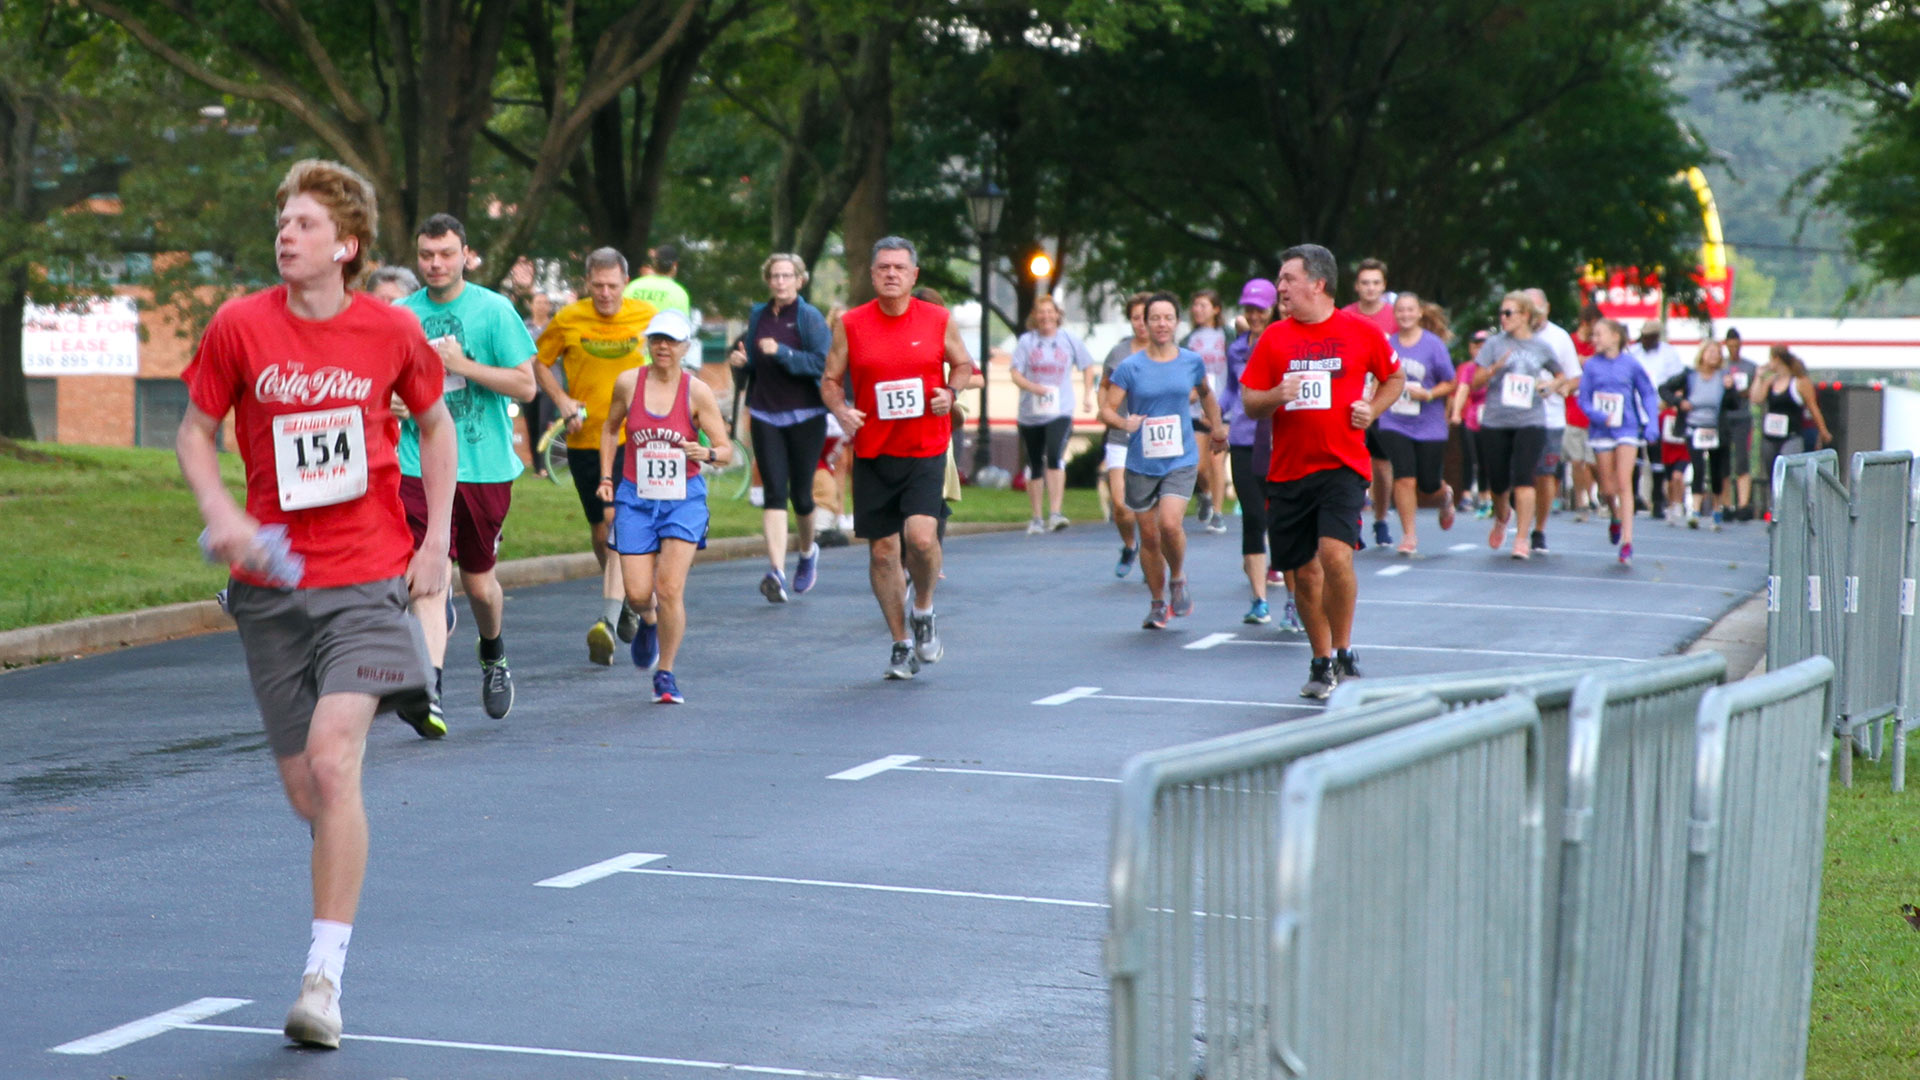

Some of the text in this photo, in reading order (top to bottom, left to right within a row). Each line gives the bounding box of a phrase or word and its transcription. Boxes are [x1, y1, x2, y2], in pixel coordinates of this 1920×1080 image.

[632, 288, 668, 302] STAFF
[96, 319, 136, 333] FOR
[49, 338, 109, 352] LEASE
[255, 363, 373, 405] Costa Rica
[886, 390, 916, 410] 155
[1149, 424, 1174, 441] 107
[293, 430, 351, 468] 154
[647, 459, 677, 478] 133
